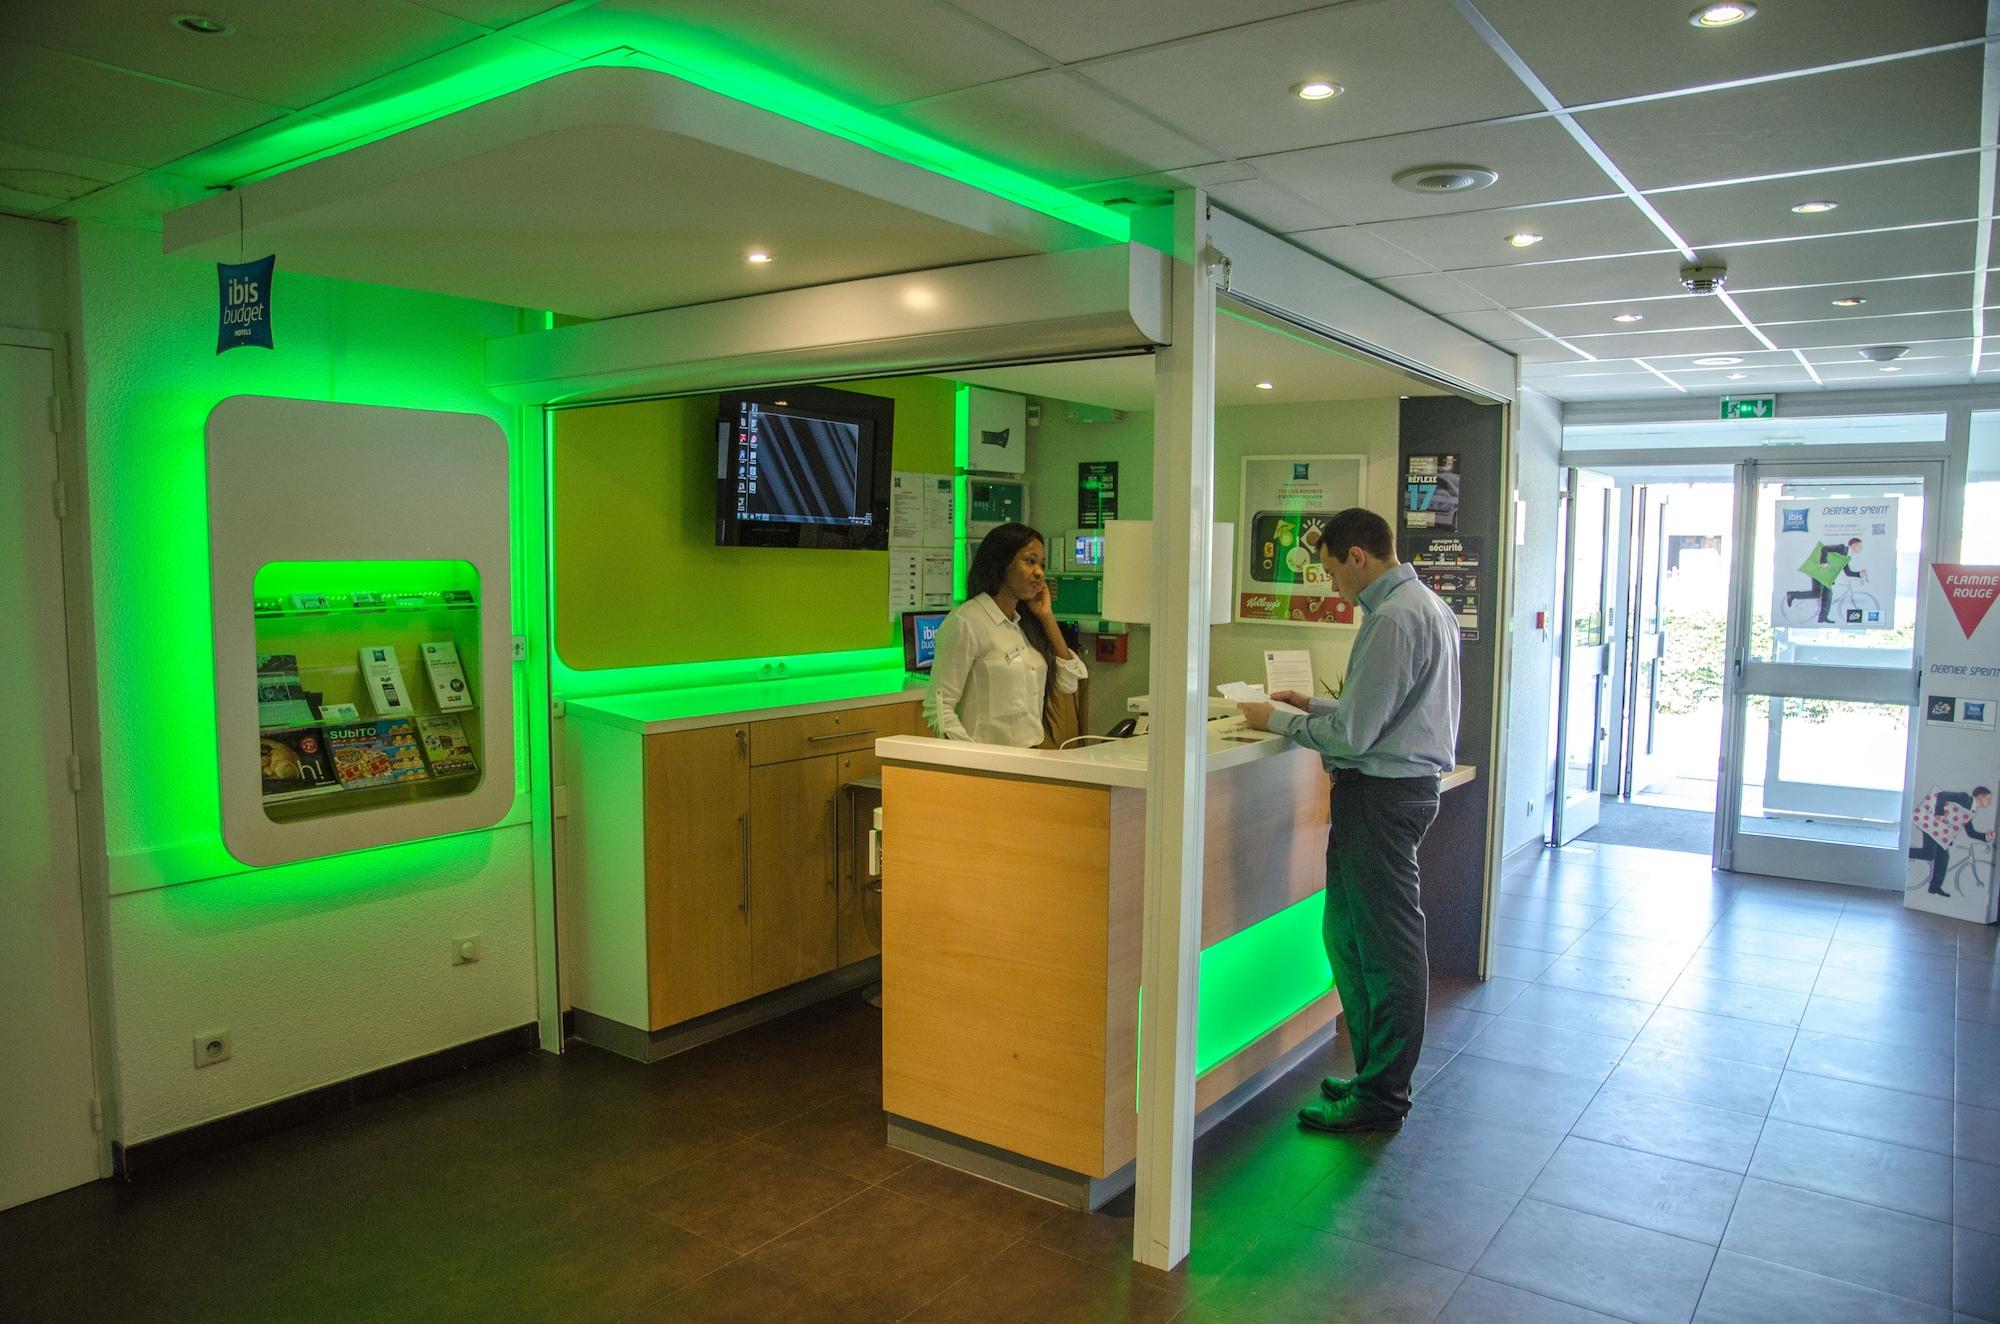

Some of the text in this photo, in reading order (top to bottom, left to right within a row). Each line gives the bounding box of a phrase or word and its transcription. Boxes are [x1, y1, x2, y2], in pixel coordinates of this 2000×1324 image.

[228, 276, 259, 306] ibis
[223, 302, 264, 327] budget
[1407, 475, 1438, 484] RÉFLEXE
[1407, 484, 1437, 512] 17
[1788, 511, 1803, 520] ibis
[1822, 505, 1889, 516] DERNIER SPRINT
[1428, 543, 1463, 552] sécurité
[1946, 575, 1999, 586] FLAMME
[1953, 588, 1993, 598] ROUGE
[923, 626, 937, 640] ibi
[1930, 664, 2000, 677] DERNIER SPRINT
[329, 727, 377, 740] SUbITO
